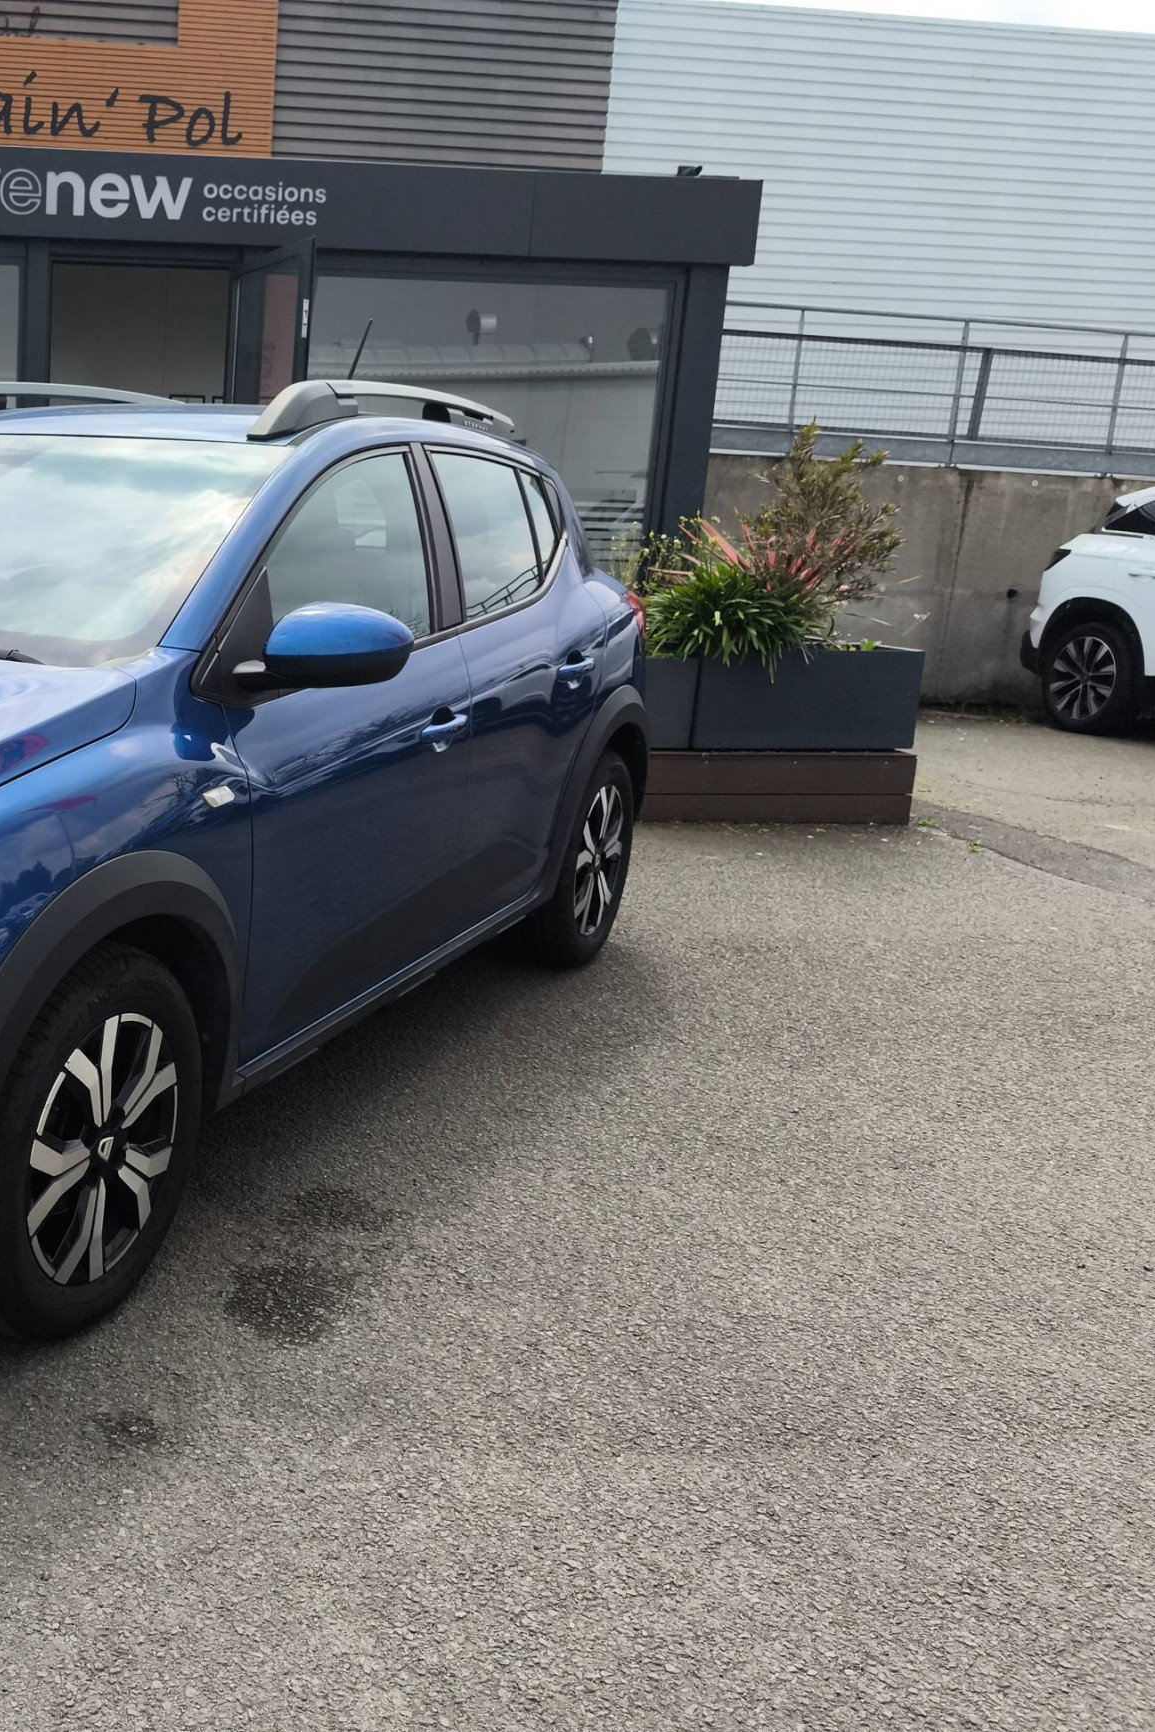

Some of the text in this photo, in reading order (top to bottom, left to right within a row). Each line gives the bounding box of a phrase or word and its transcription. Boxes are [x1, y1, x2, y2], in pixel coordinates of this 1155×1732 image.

[139, 91, 243, 147] Pol
[203, 181, 327, 204] occasions
[202, 203, 318, 226] certifiées
